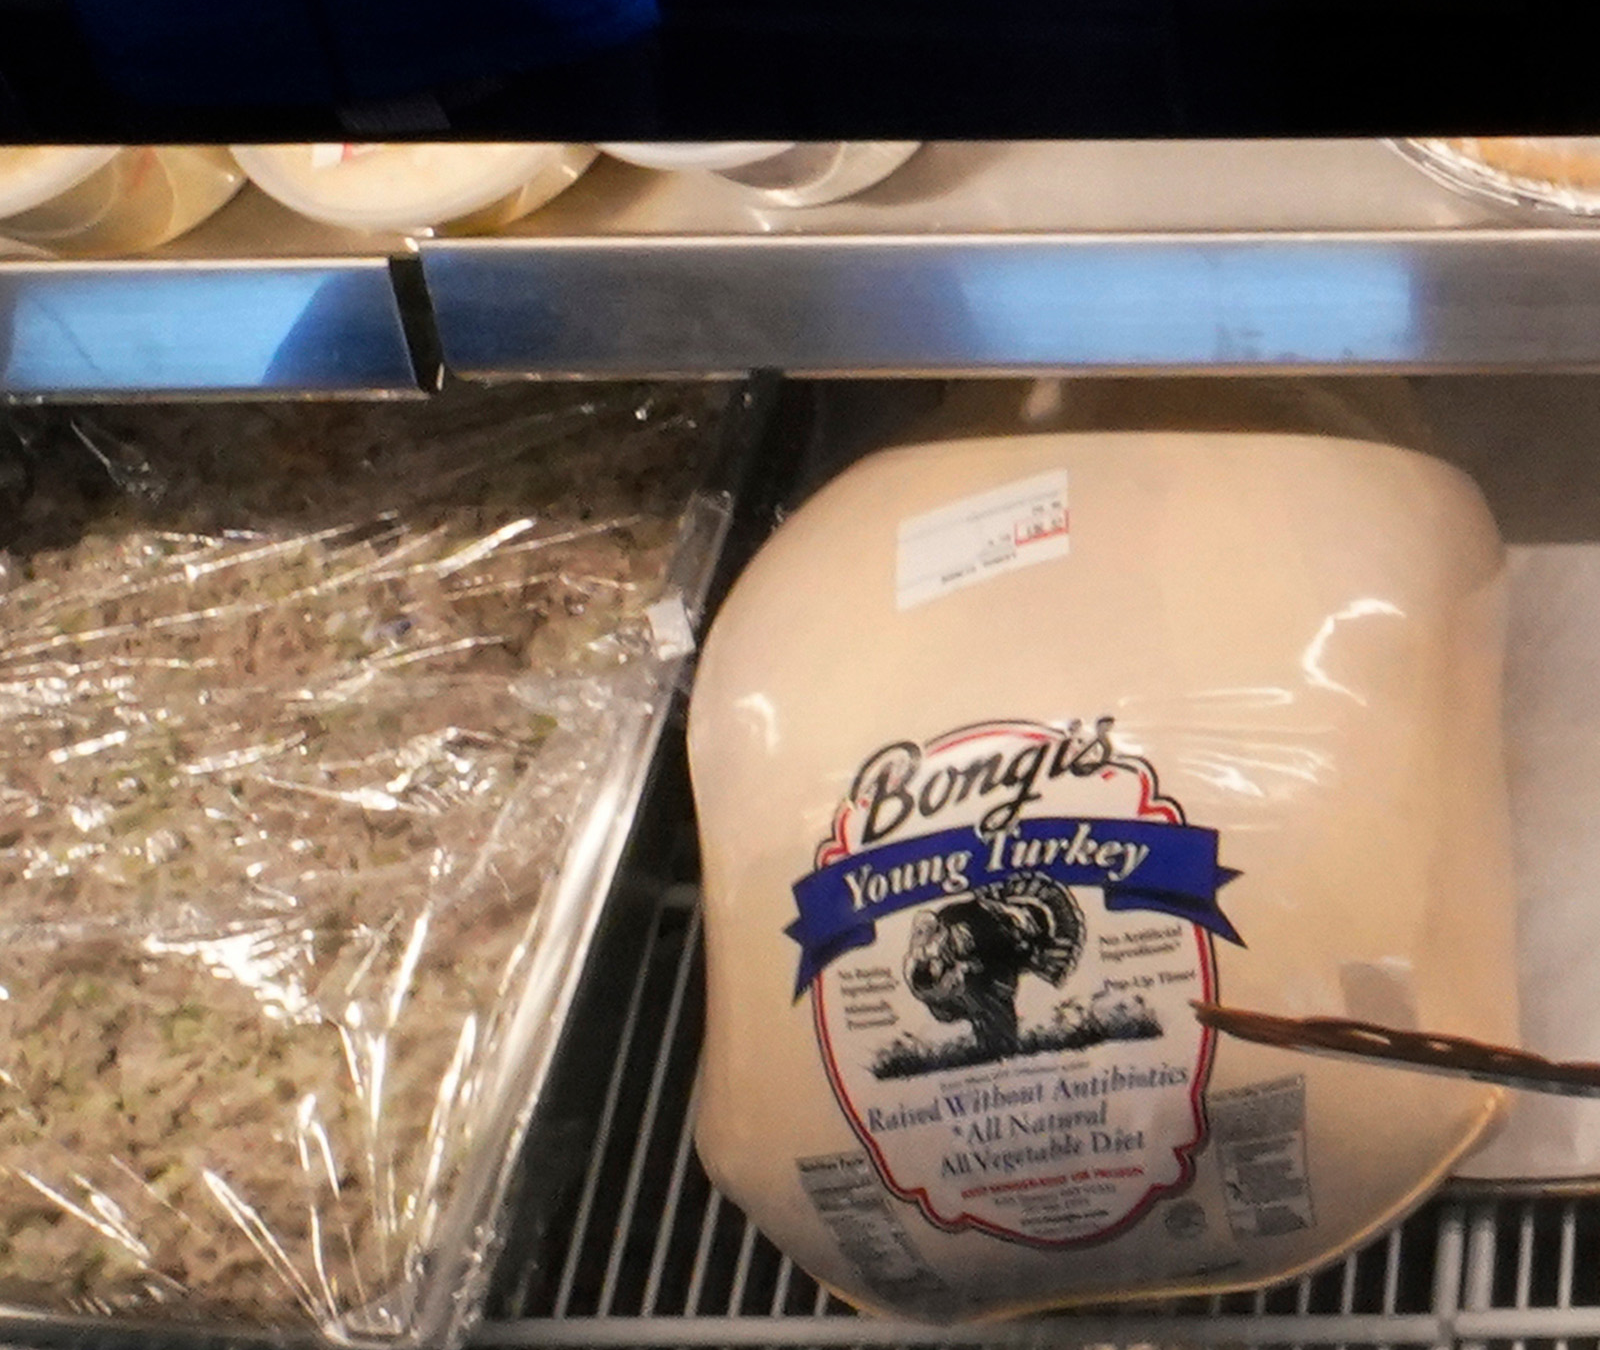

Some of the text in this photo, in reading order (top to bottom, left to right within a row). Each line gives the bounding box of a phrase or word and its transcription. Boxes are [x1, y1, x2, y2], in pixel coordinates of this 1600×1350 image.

[843, 821, 1150, 910] Young Turkey
[941, 1155, 970, 1177] All
[1091, 1127, 1145, 1152] Diet
